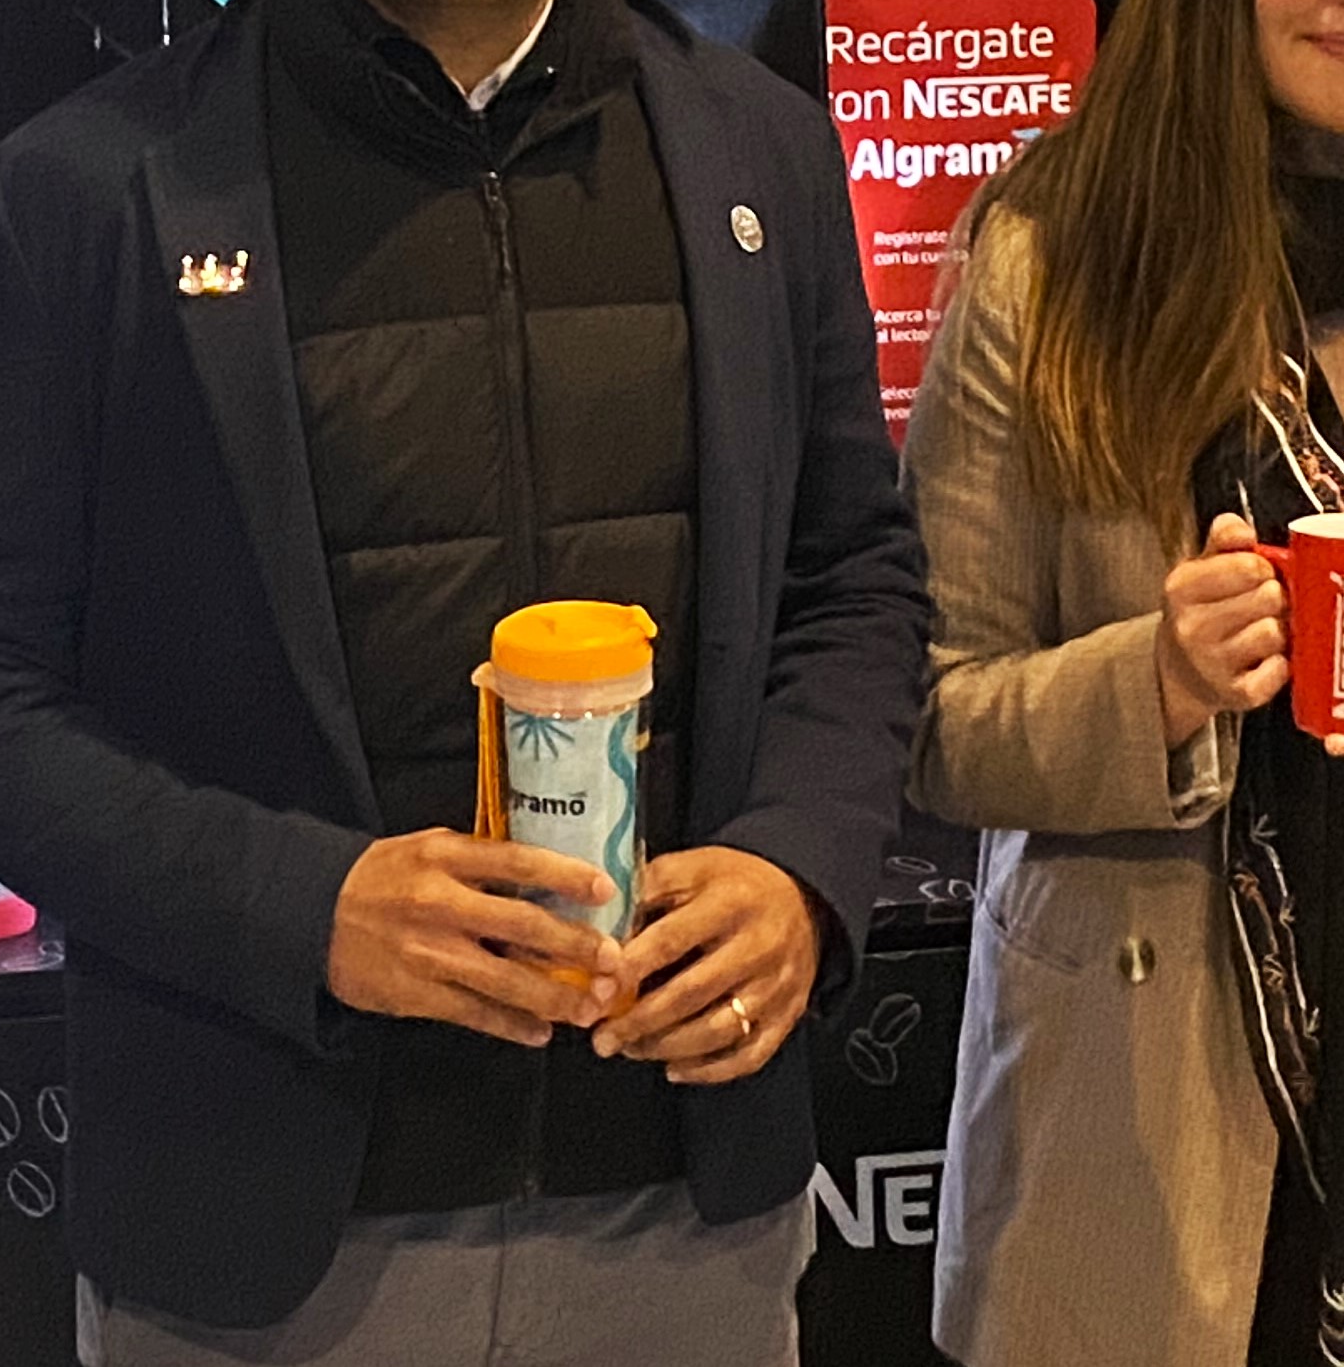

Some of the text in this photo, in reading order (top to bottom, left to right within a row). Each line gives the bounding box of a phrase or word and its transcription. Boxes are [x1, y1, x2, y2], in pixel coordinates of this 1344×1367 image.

[824, 19, 1055, 70] Recárgate
[828, 87, 891, 122] on
[850, 138, 1030, 188] Algram
